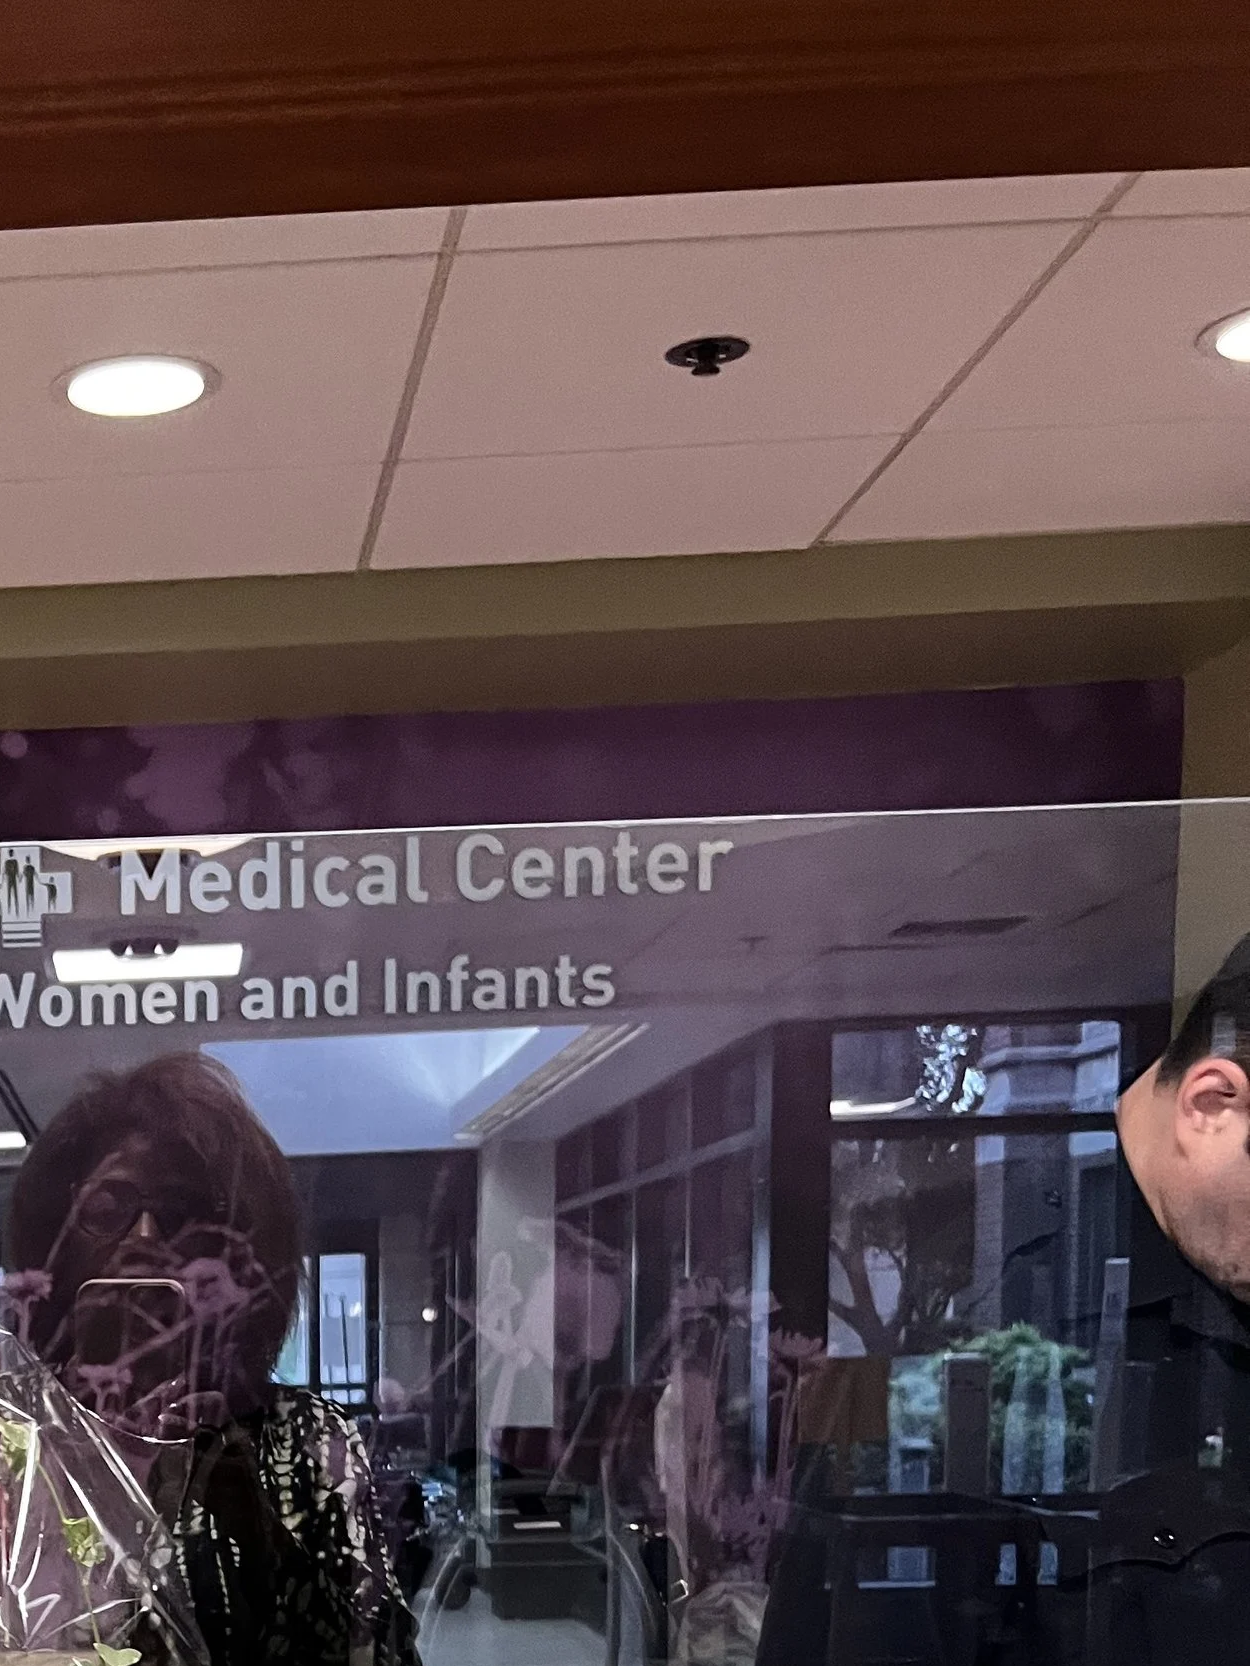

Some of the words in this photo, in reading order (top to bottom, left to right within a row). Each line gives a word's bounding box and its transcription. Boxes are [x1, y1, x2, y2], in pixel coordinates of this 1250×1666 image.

[121, 836, 429, 915] Medical
[456, 831, 734, 902] Center
[241, 960, 358, 1020] and
[384, 954, 616, 1014] Infants
